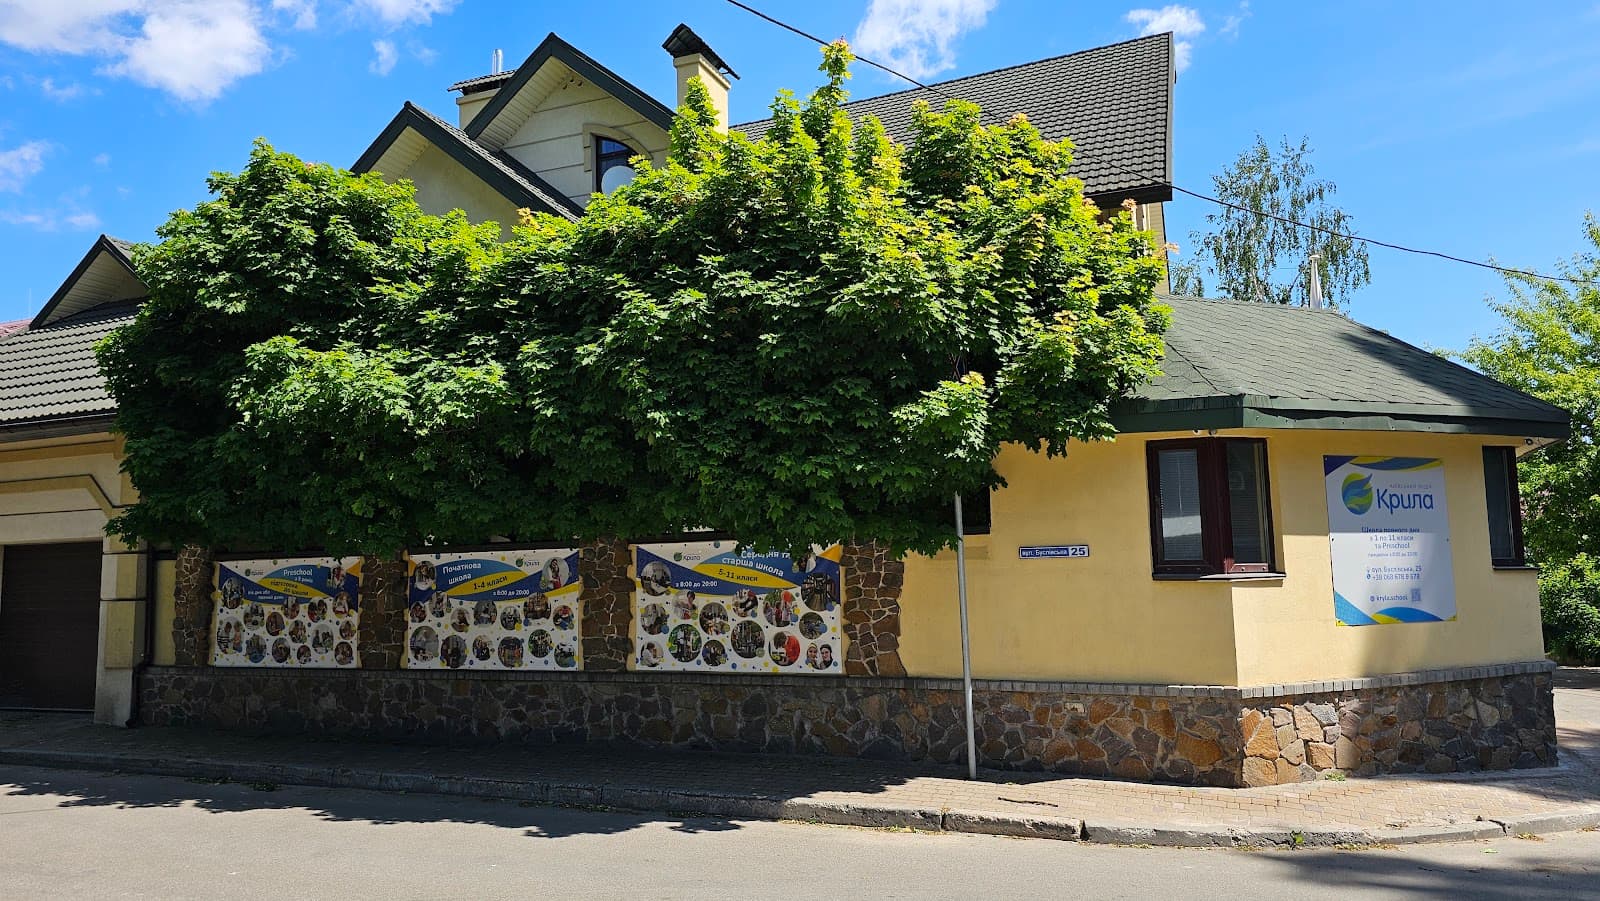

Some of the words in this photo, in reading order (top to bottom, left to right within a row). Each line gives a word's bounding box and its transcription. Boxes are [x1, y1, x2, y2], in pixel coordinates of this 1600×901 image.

[1376, 488, 1434, 515] Крила
[1070, 547, 1086, 556] 25
[283, 568, 313, 576] Preschool
[442, 562, 482, 575] Початкова
[721, 557, 754, 567] старша
[755, 561, 784, 577] школа
[448, 573, 472, 585] школа
[718, 568, 735, 579] 5-11
[736, 574, 758, 582] класи
[473, 581, 485, 590] 1-4
[486, 576, 508, 588] класи
